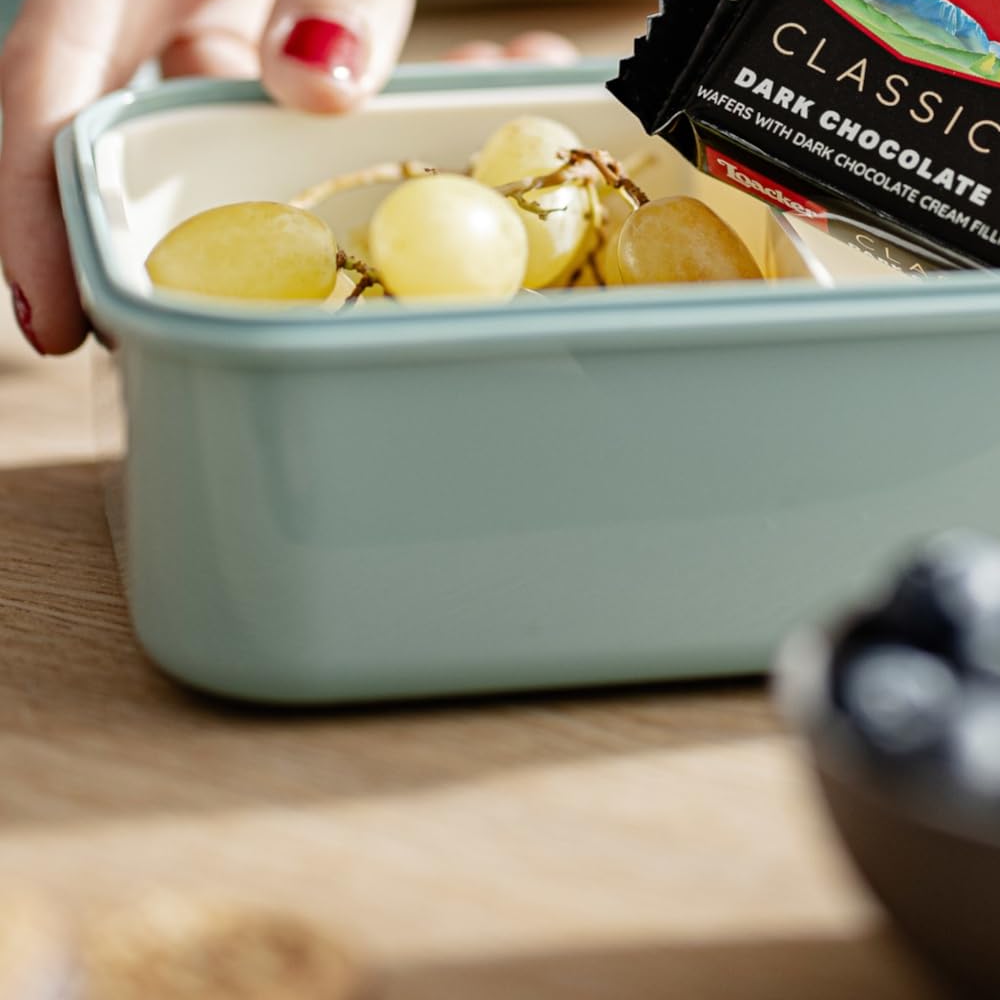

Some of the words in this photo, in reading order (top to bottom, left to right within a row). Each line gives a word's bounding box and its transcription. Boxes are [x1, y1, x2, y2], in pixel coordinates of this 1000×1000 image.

[697, 85, 754, 120] WAFERS
[755, 112, 793, 140] WITH
[792, 133, 835, 160] DARK
[834, 153, 920, 203] CHOCOLATE
[919, 195, 970, 228] CREAM
[717, 158, 819, 219] Loacker
[734, 66, 816, 119] DARK
[819, 110, 992, 206] CHOCOLATE
